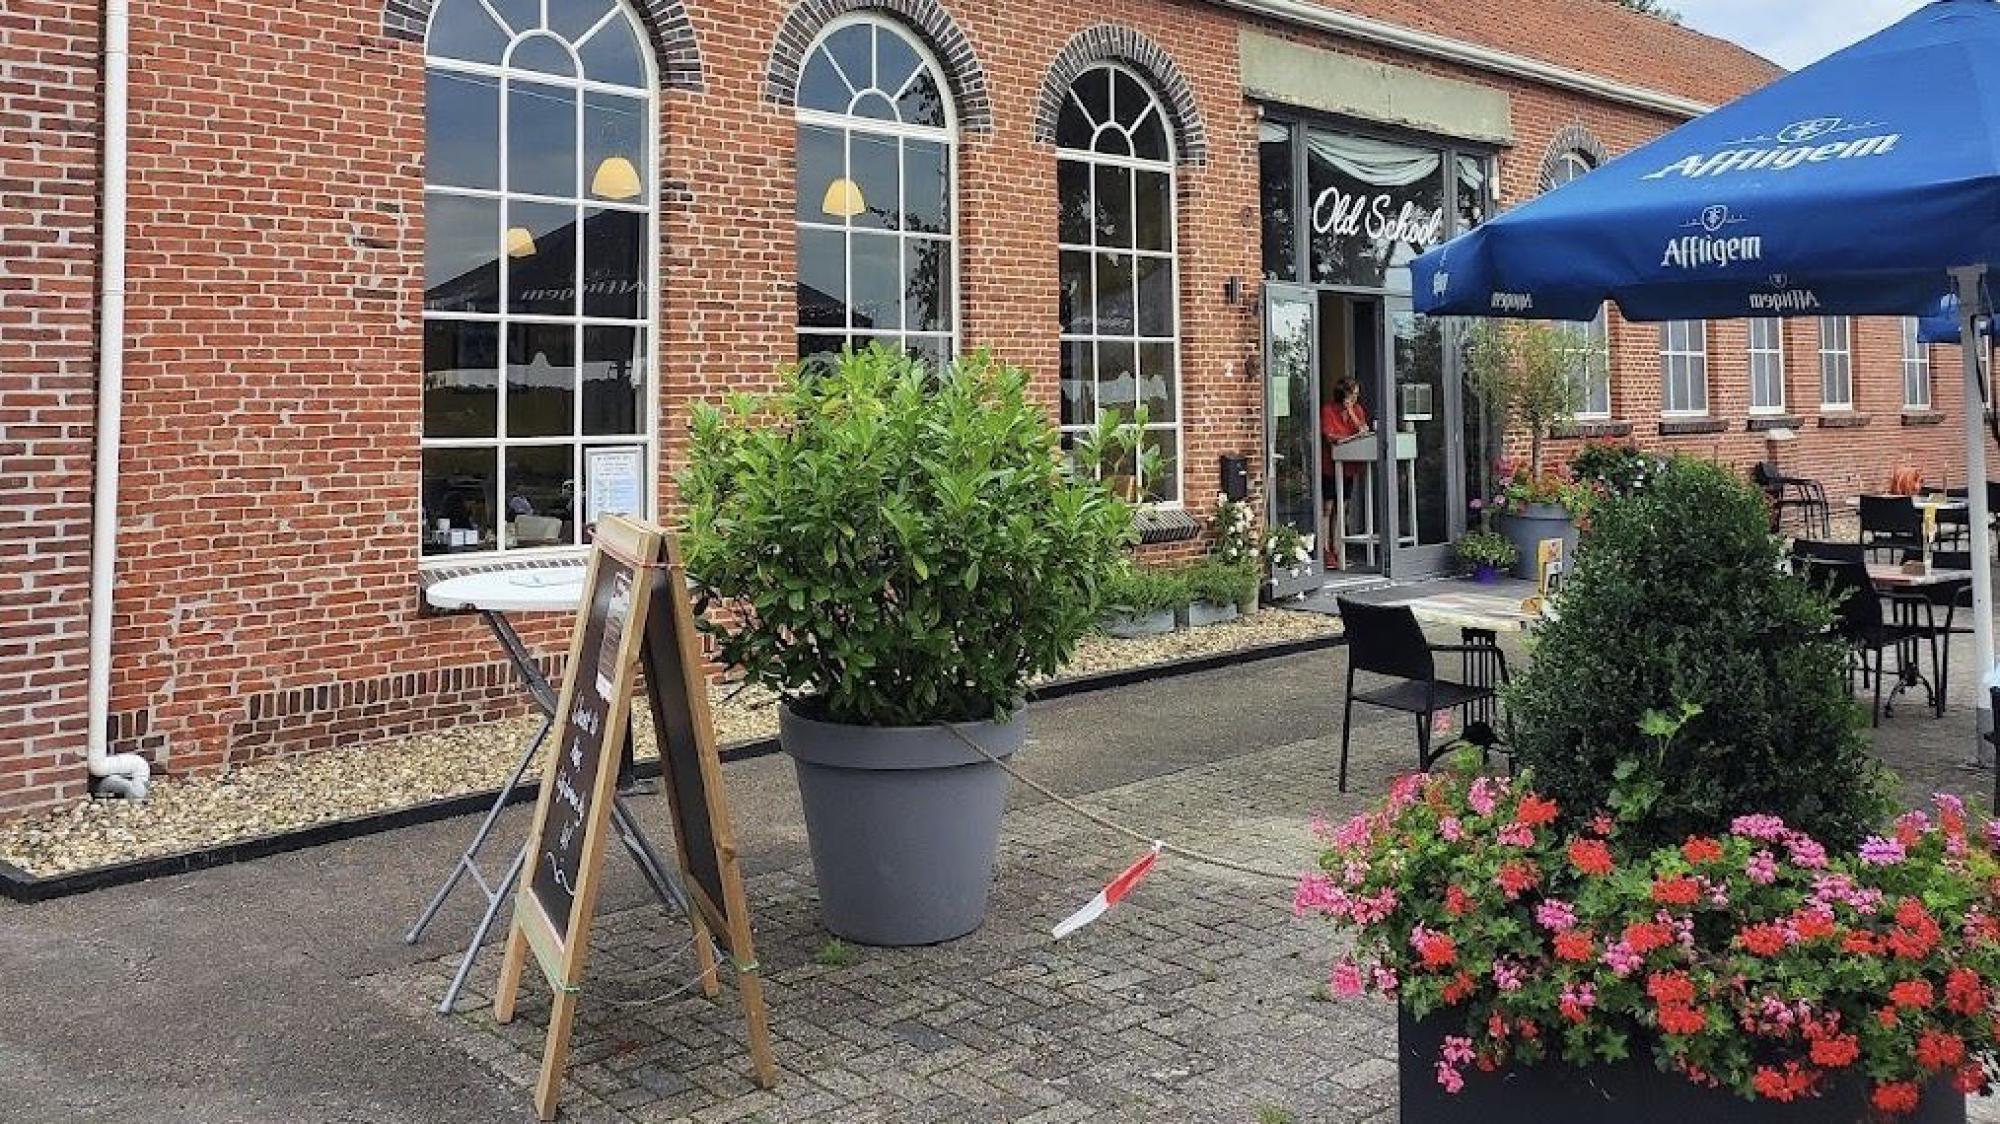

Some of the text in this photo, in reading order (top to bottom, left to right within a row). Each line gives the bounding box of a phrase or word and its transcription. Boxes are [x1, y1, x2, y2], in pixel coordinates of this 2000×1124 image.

[1640, 134, 1902, 178] Affligem
[1313, 187, 1442, 245] Old School
[1661, 235, 1762, 269] Affligem
